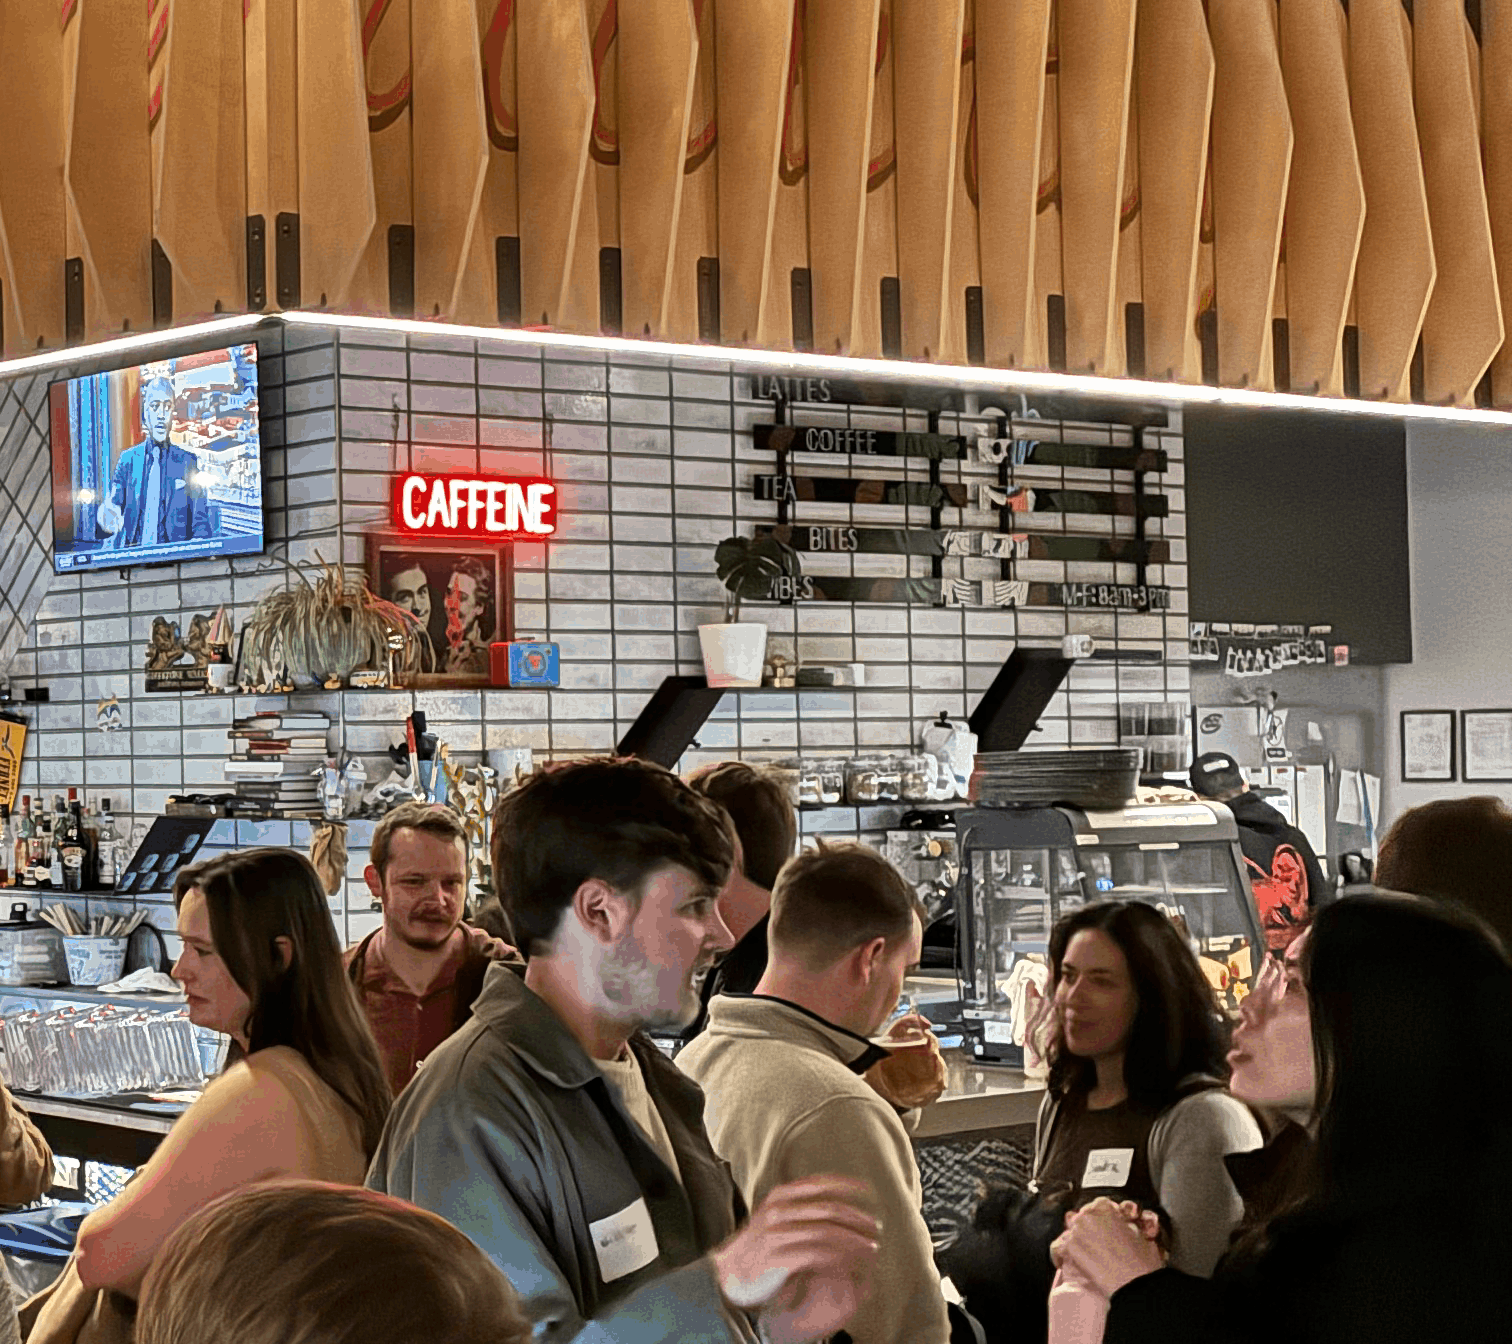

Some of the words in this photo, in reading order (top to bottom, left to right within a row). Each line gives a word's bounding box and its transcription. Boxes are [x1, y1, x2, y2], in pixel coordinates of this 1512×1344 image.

[757, 375, 831, 402] LATTES
[806, 428, 877, 454] COFFEE
[760, 476, 797, 500] TEA
[402, 476, 555, 534] CAFFEINE
[809, 527, 858, 551] BITES
